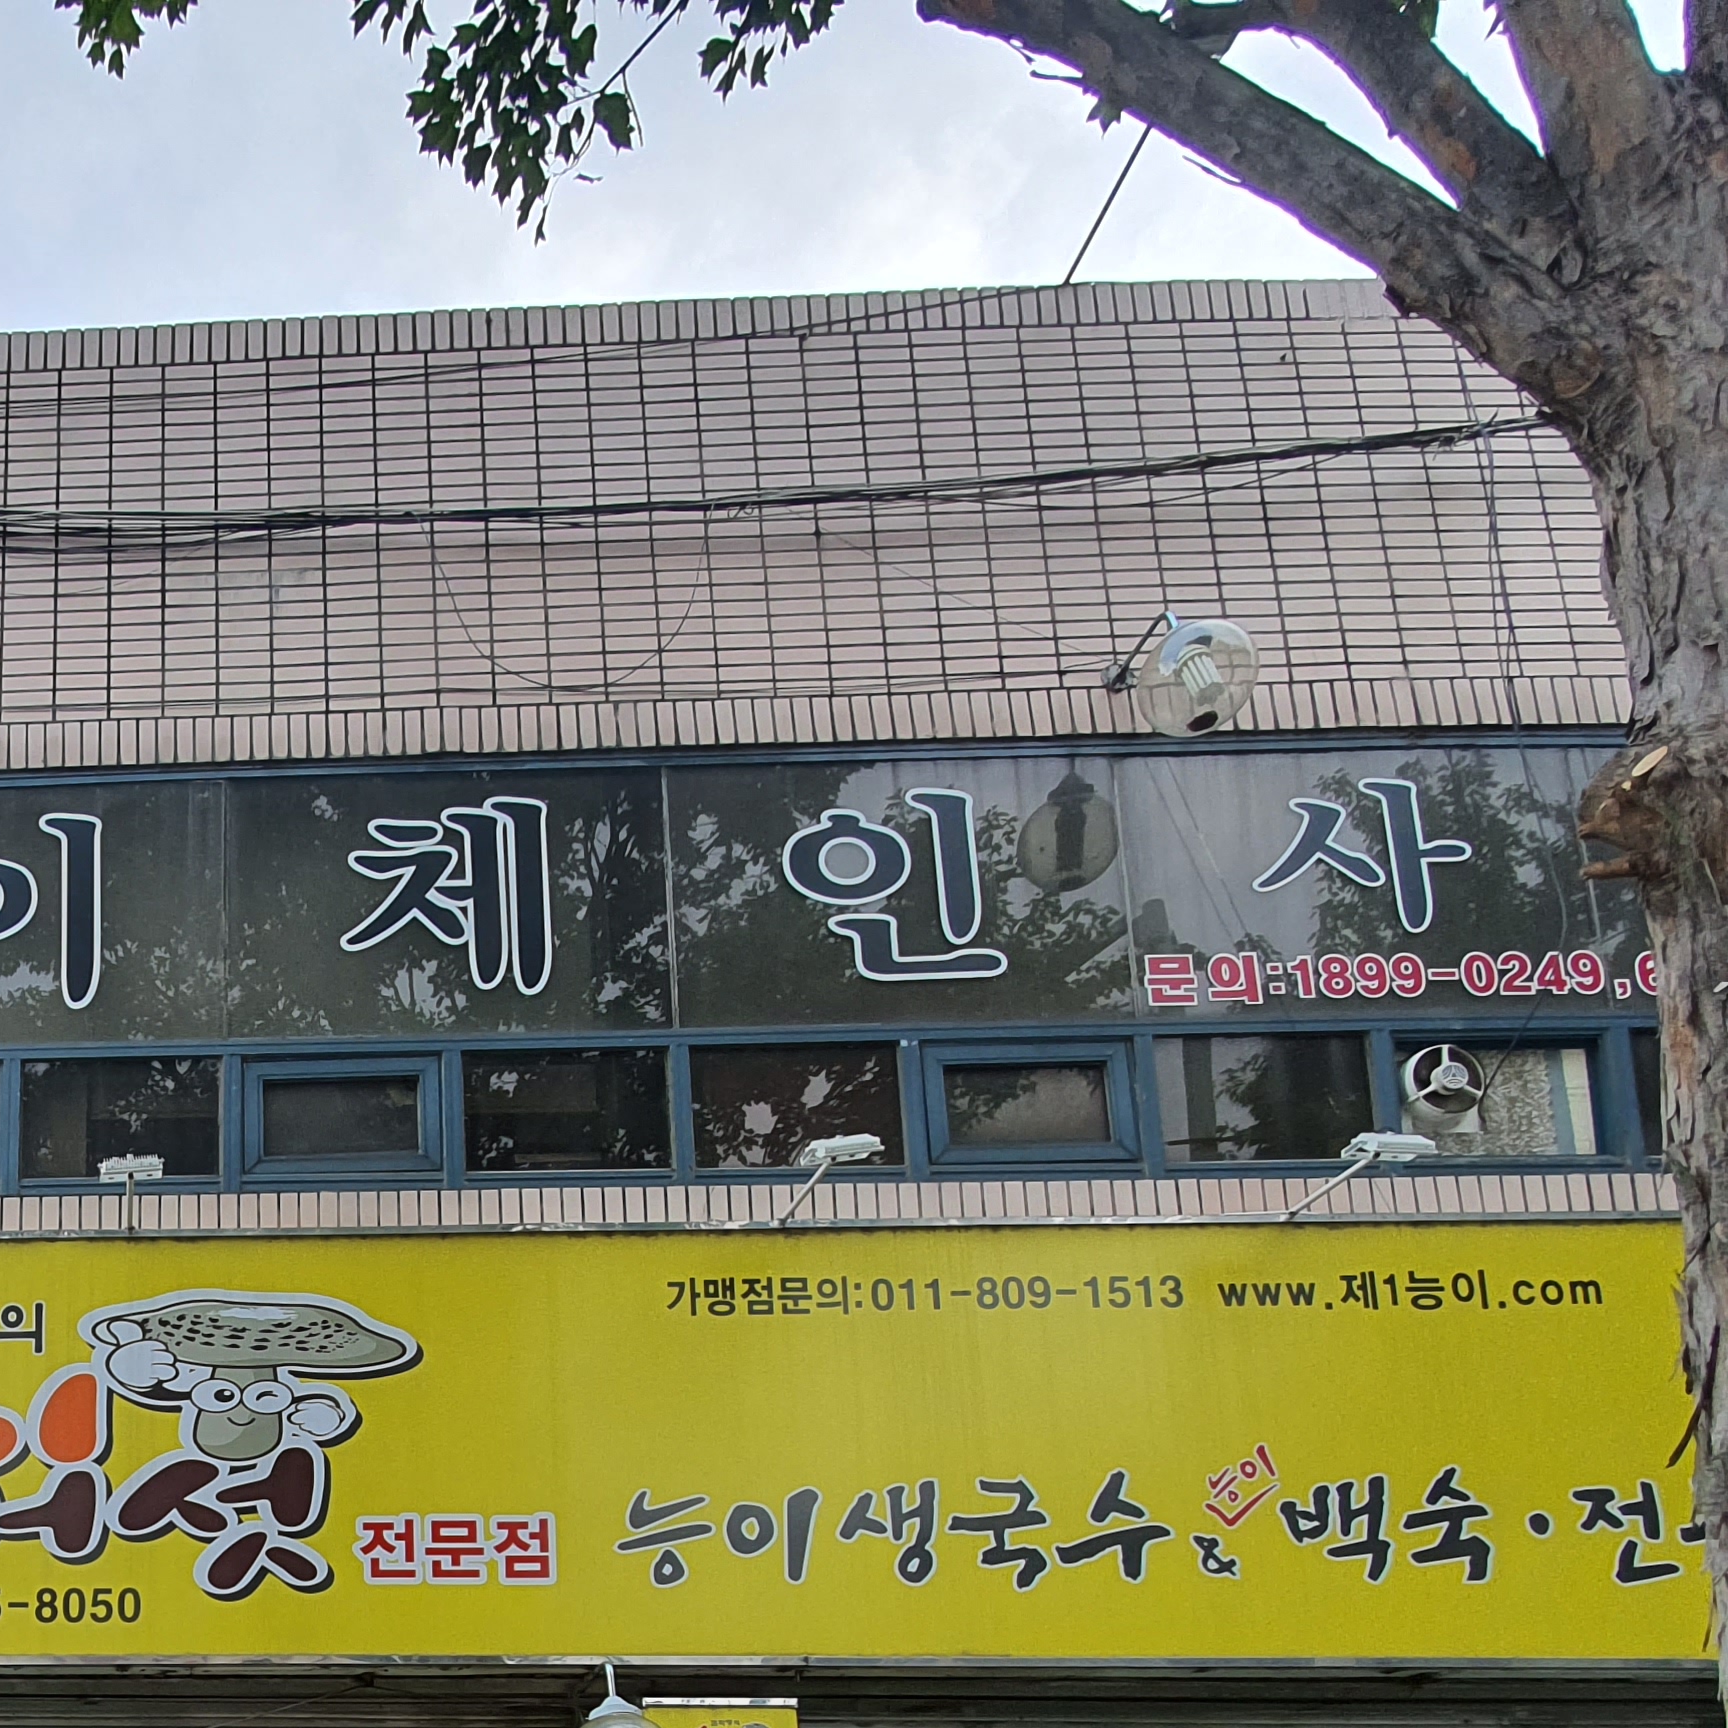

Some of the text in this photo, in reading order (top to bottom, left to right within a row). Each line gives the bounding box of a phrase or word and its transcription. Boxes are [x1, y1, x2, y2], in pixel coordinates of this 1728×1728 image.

[665, 1274, 1185, 1317] 가맹점문의:011-809-1513
[1217, 1269, 1604, 1311] www.제1능이.com
[353, 1512, 558, 1586] 전문점
